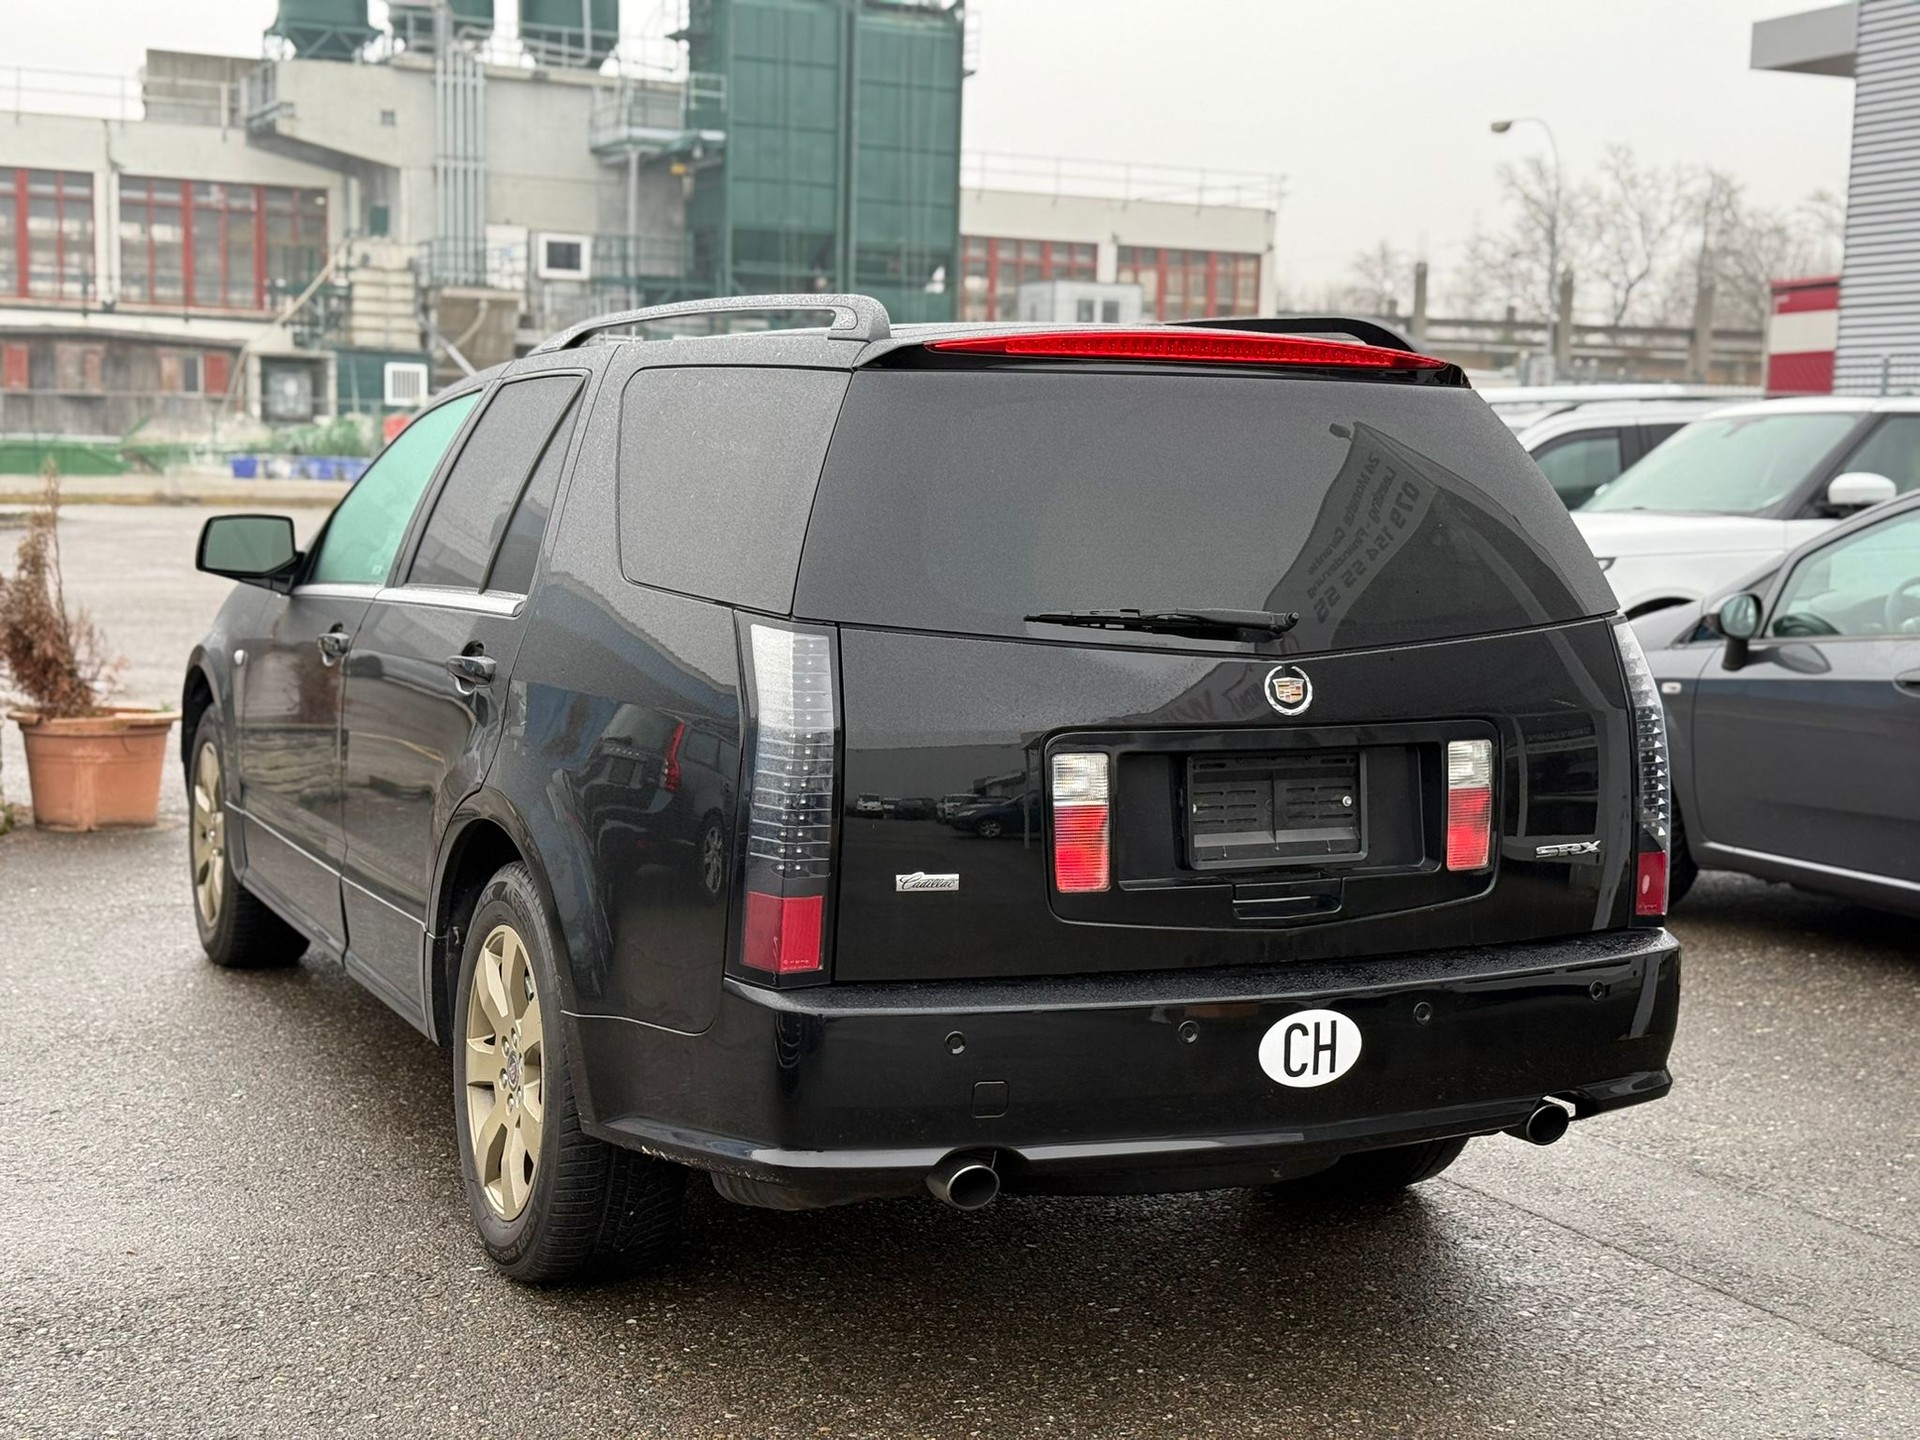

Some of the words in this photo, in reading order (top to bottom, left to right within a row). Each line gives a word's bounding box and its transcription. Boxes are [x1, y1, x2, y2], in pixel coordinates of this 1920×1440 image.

[1535, 840, 1601, 859] SRX
[899, 873, 956, 890] Cadillac
[1283, 1020, 1337, 1078] CH
